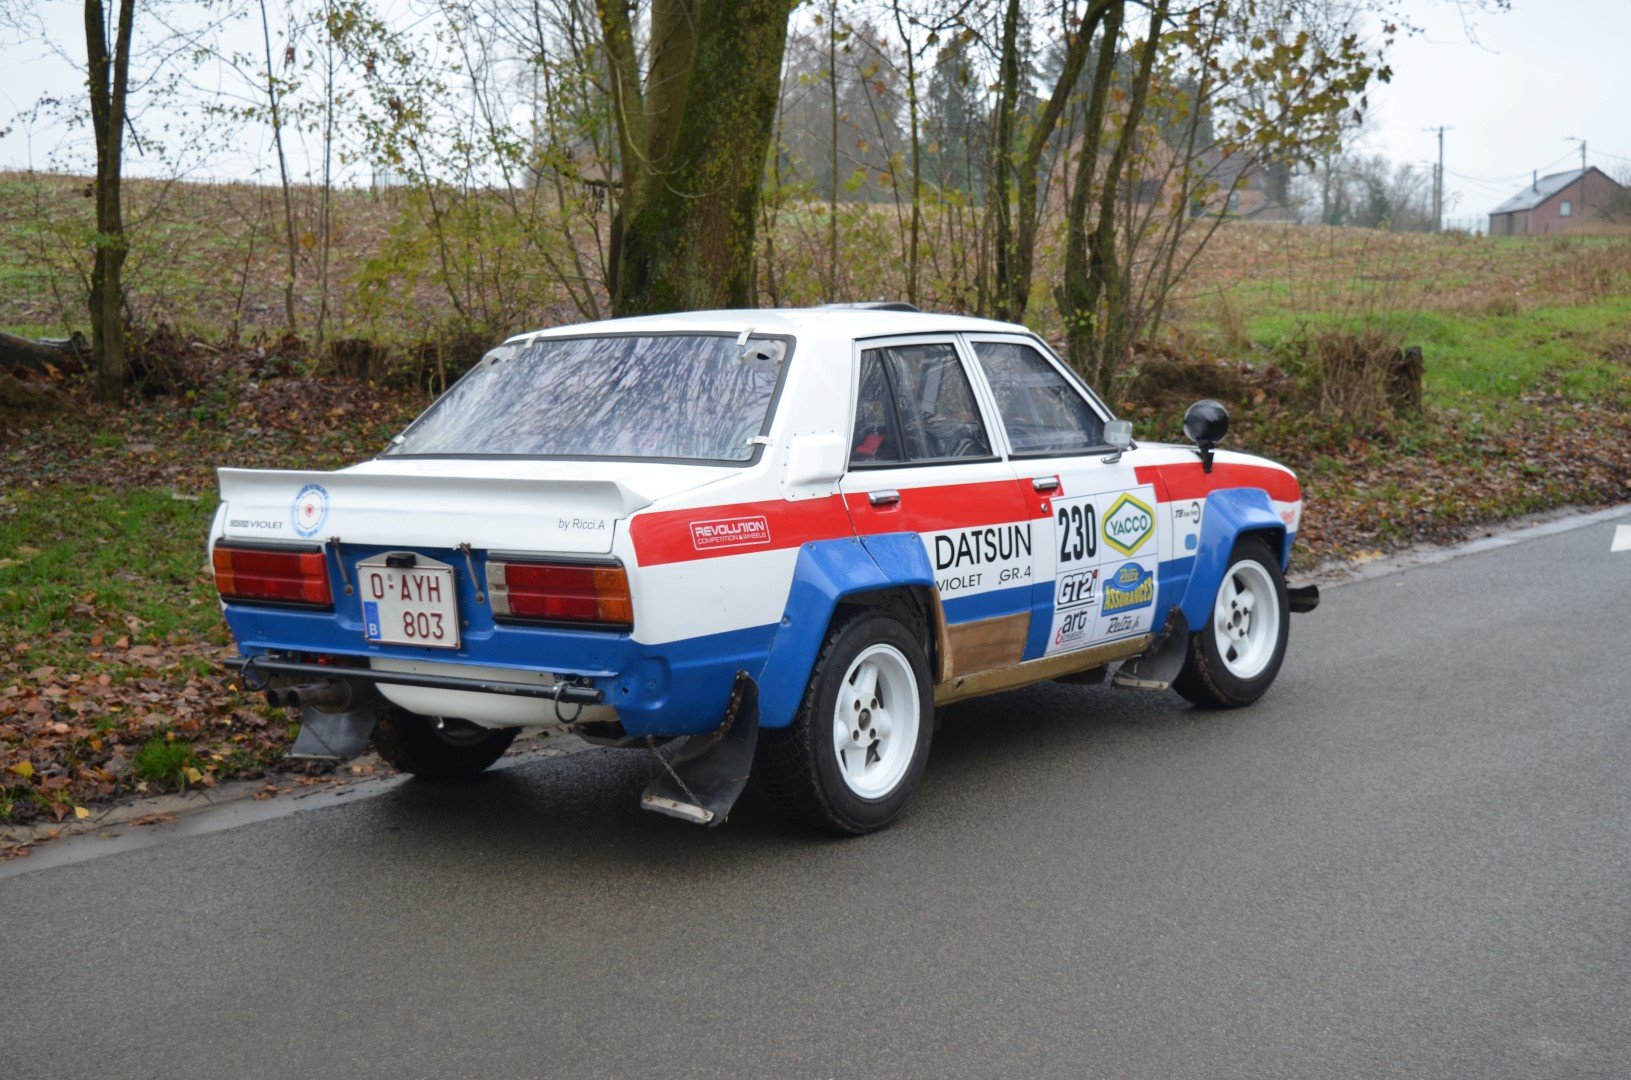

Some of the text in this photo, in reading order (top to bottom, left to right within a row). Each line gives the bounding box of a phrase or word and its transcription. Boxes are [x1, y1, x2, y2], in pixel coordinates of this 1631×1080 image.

[250, 520, 283, 529] VIOLET
[558, 518, 570, 531] by
[695, 521, 765, 537] REVOLUTION
[1058, 503, 1097, 563] 230
[1110, 515, 1148, 535] YACCO
[697, 531, 767, 545] COMPETITION WHEELS
[935, 523, 1032, 571] DATSUN
[936, 573, 982, 592] VIOLET
[369, 623, 378, 636] B
[403, 610, 445, 640] 803
[1062, 610, 1087, 635] art
